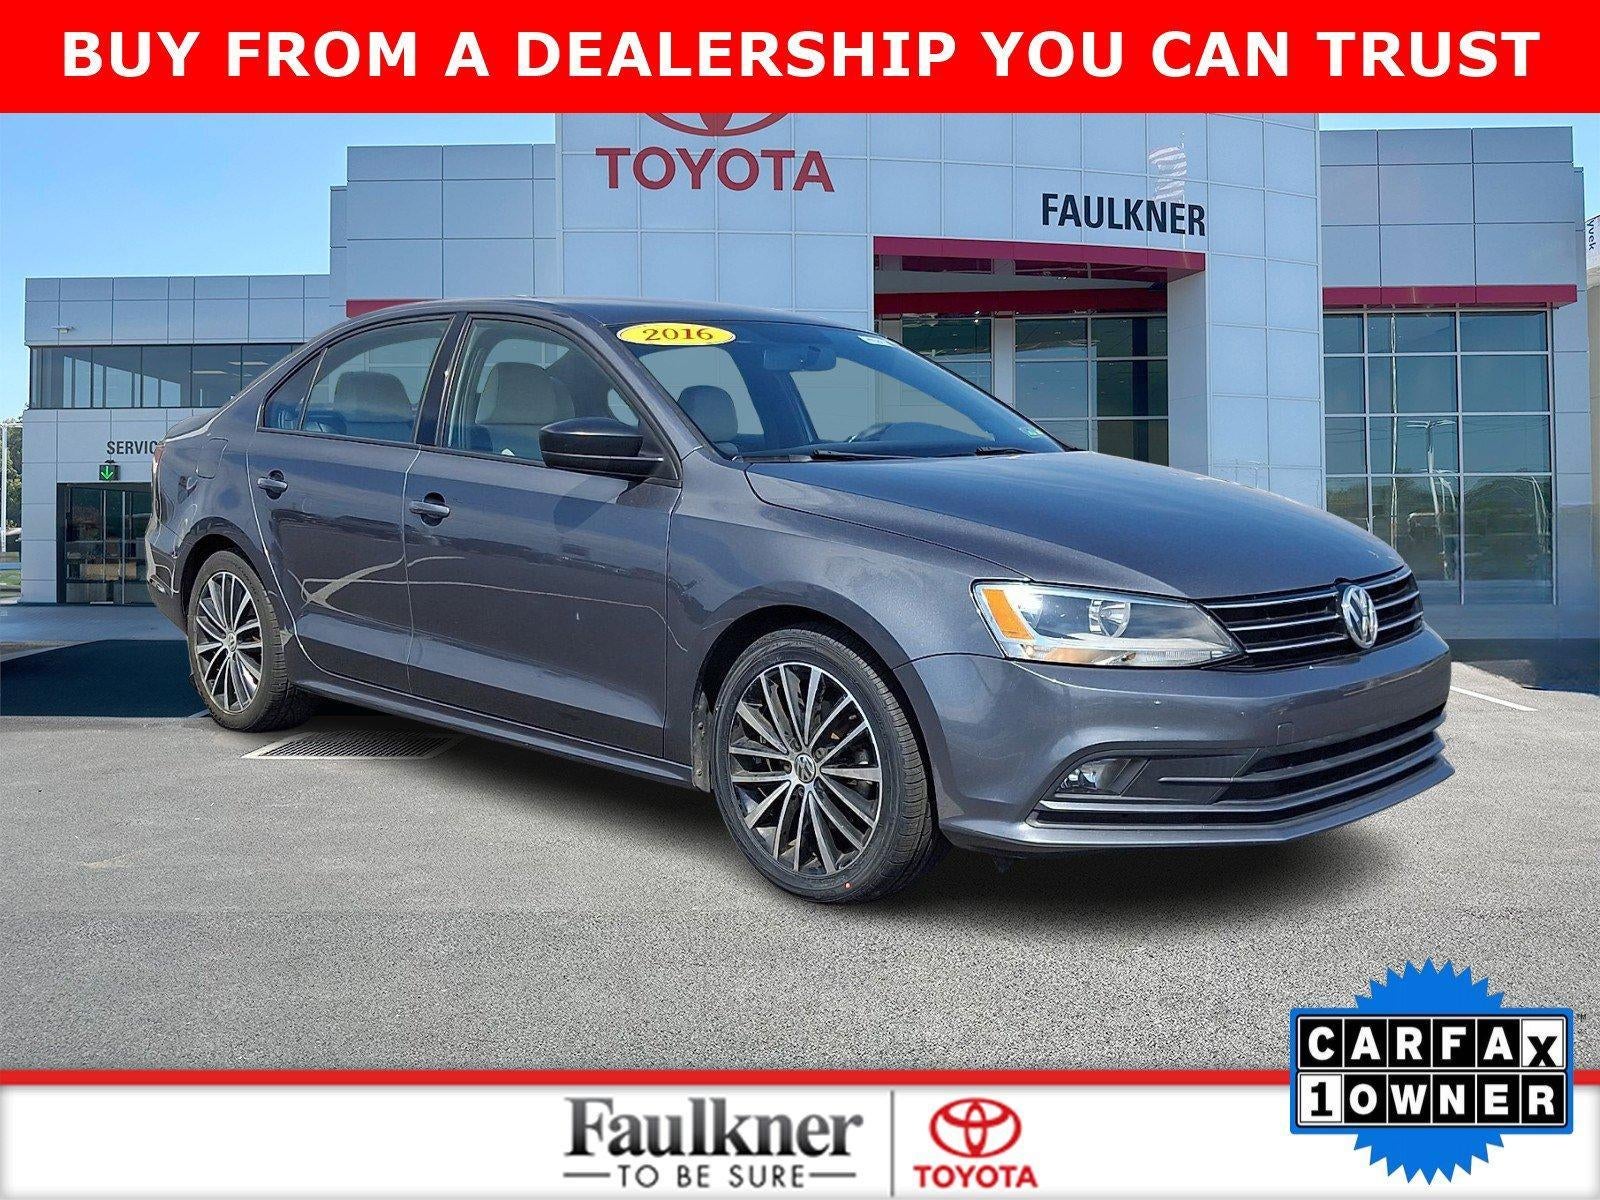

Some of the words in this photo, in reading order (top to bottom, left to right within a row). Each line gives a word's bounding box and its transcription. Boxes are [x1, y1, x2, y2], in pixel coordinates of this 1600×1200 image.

[595, 146, 836, 193] TOYOTA
[1042, 193, 1206, 237] FAULKNER
[642, 328, 714, 341] 2016
